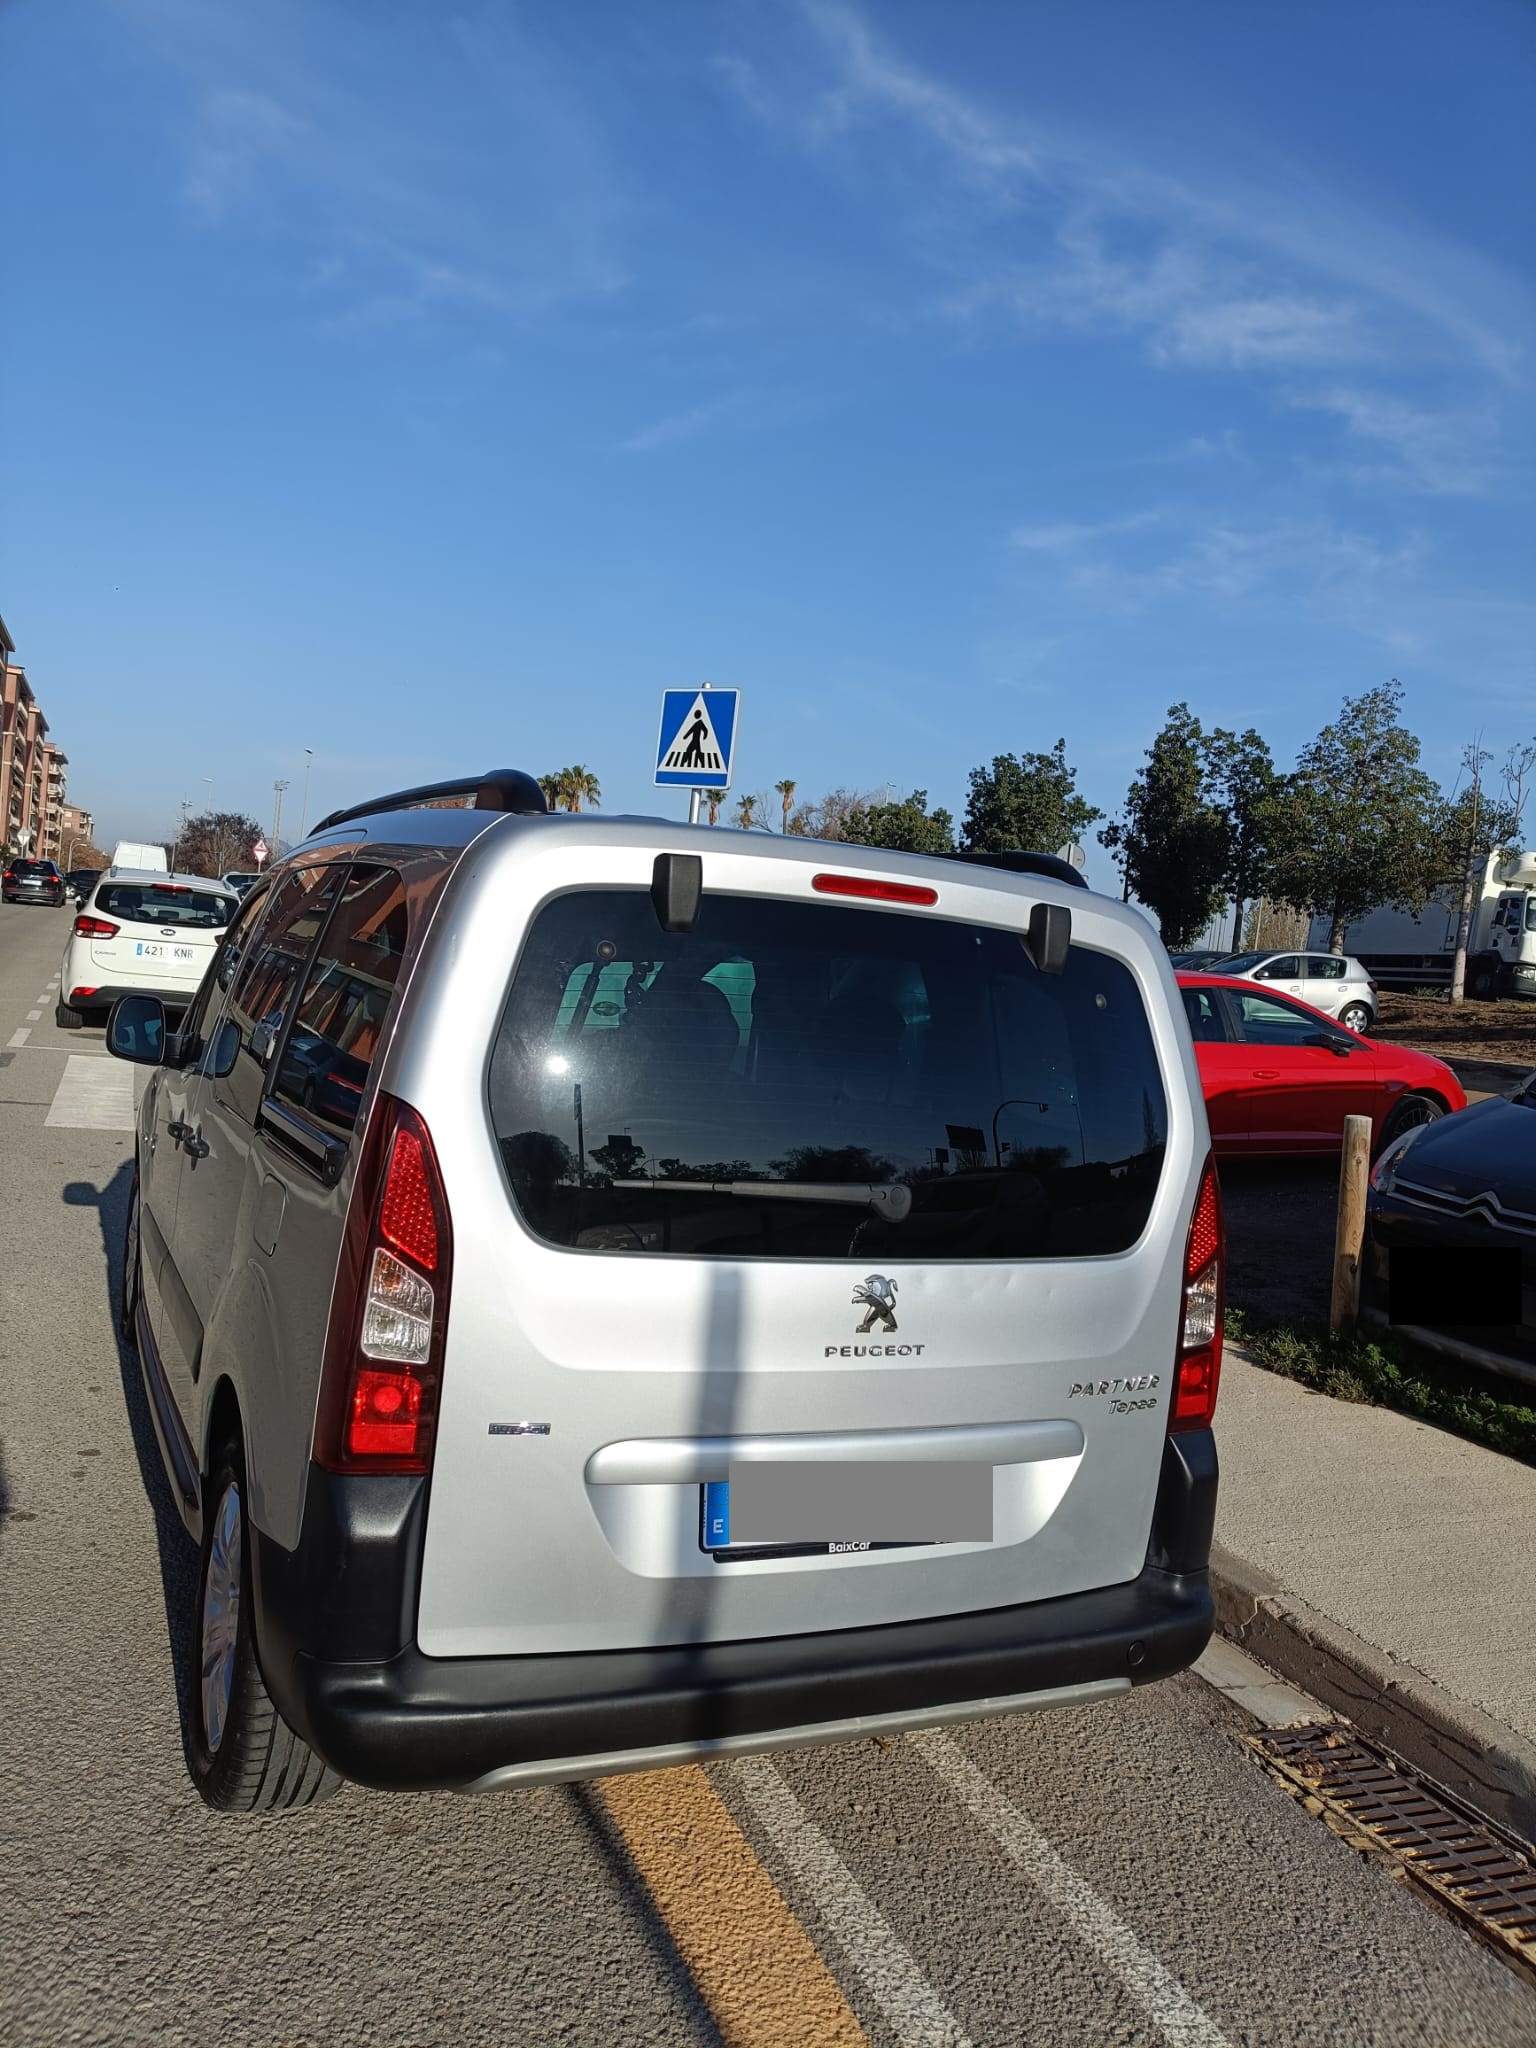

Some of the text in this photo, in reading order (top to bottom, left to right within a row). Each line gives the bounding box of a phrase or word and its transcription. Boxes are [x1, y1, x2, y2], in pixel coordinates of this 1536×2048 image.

[144, 945, 194, 959] 421 KNR
[824, 1344, 925, 1358] PEUGEOT
[1066, 1374, 1160, 1399] PARTNER
[1109, 1398, 1157, 1415] Tepee
[712, 1518, 724, 1534] E
[828, 1541, 871, 1554] BaixCar
